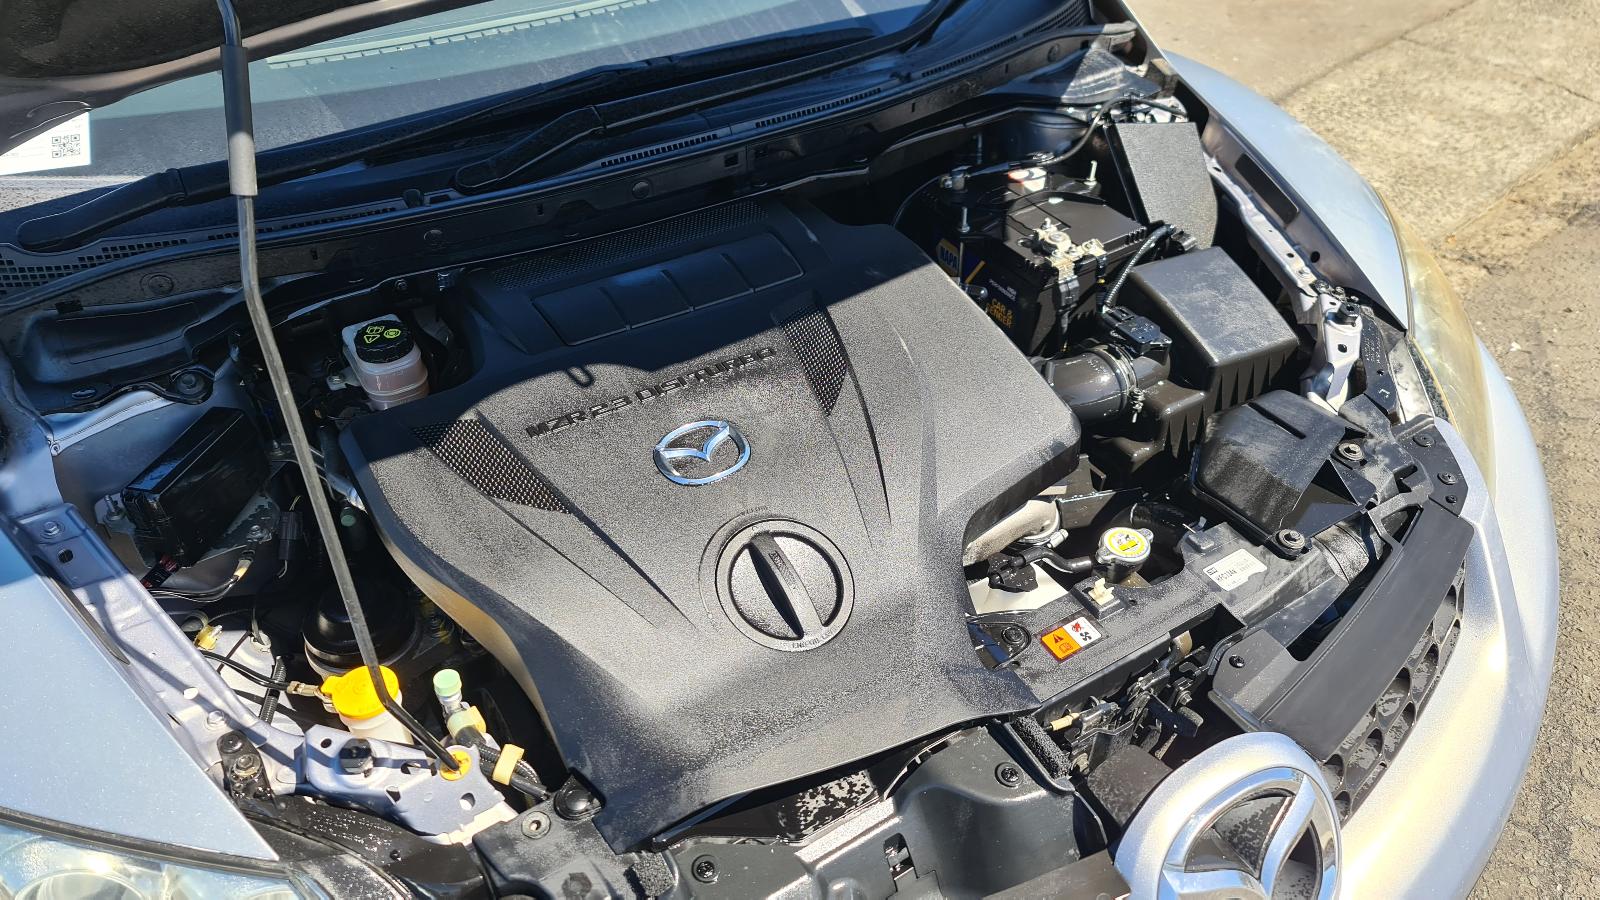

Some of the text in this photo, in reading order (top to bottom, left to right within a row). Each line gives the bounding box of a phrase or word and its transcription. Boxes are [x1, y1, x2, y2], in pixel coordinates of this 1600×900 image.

[940, 246, 959, 272] NAPA
[991, 298, 1006, 313] CAR
[525, 411, 588, 438] MZR
[635, 376, 688, 402] DISI
[687, 347, 777, 381] TURBO
